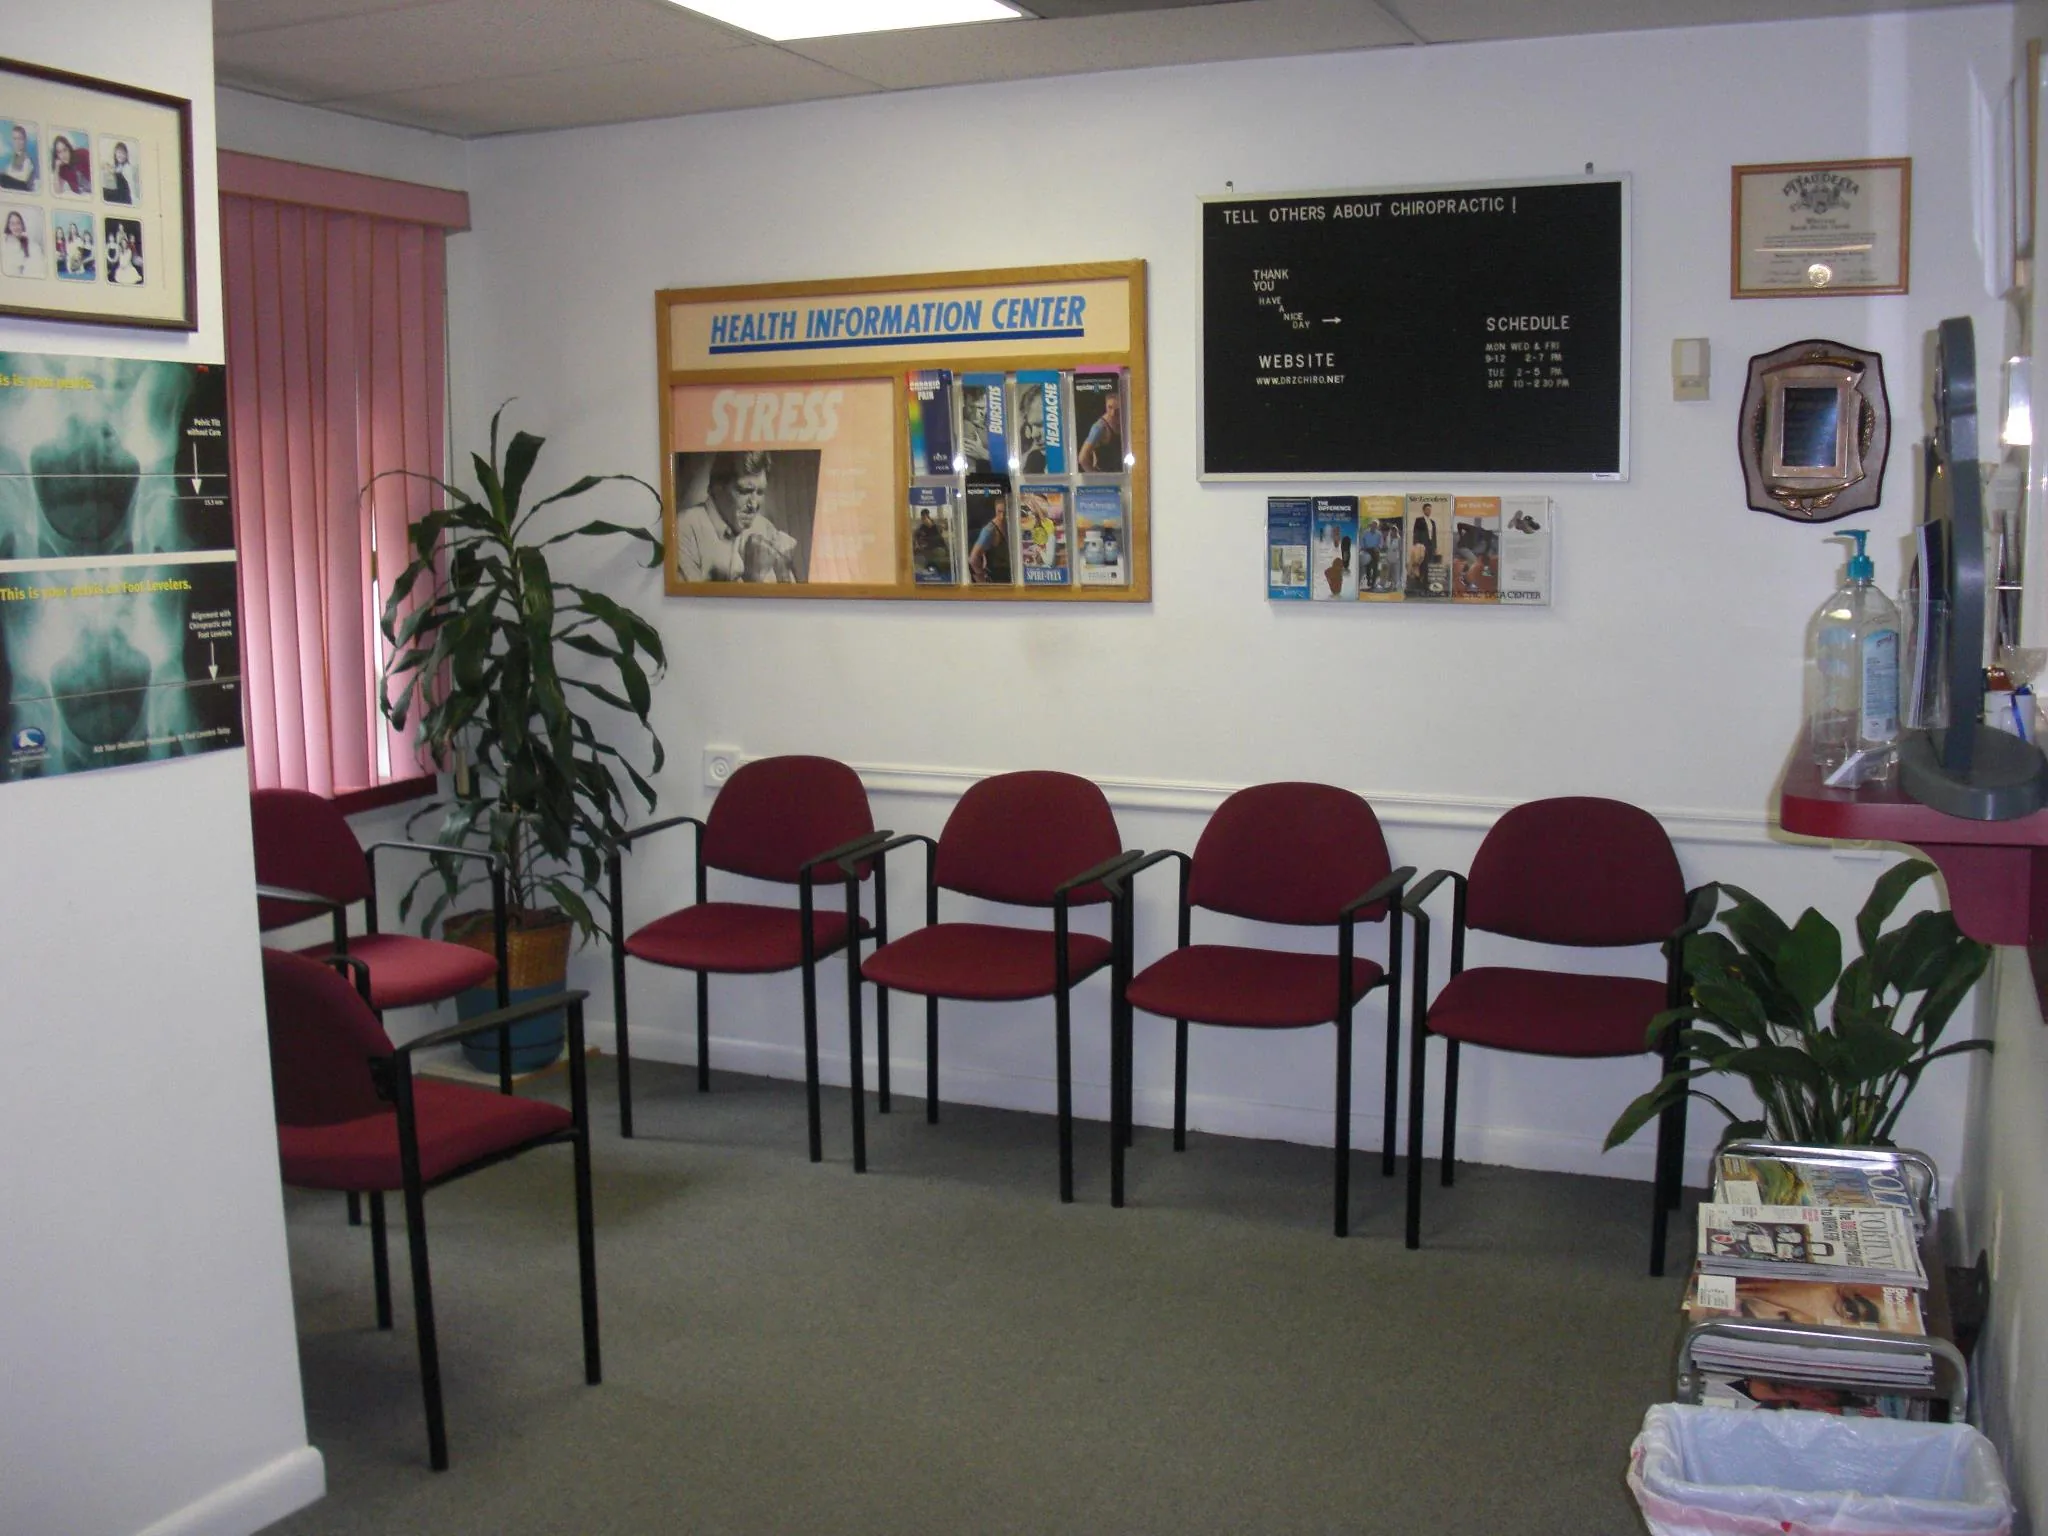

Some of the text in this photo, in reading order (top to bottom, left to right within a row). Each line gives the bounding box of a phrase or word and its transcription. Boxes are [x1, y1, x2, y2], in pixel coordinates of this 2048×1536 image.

[1223, 208, 1259, 225] TELL
[1269, 206, 1326, 223] OTHERS
[1333, 202, 1382, 219] ABOUT
[1390, 197, 1505, 216] CHIROPRACTIC
[1252, 268, 1290, 281] THANK
[1252, 280, 1275, 292] YOU
[1258, 296, 1282, 306] HAVE
[1279, 304, 1285, 313] A
[711, 295, 1087, 344] HEALTH INFORMATION CENTER
[1283, 312, 1304, 321] NICE
[1292, 320, 1311, 329] DAY
[1486, 314, 1571, 332] SCHEDULE
[1485, 342, 1506, 351] MON
[1510, 341, 1530, 351] WED
[1545, 341, 1560, 351] FRI
[1258, 353, 1336, 369] WEBSITE
[1487, 367, 1506, 378] TUE
[1487, 379, 1504, 389] SAT
[988, 385, 1004, 435] BURSITIS
[1044, 382, 1061, 447] HEADACHE
[707, 388, 844, 447] STRESS
[0, 587, 26, 601] This
[29, 586, 40, 600] is
[122, 582, 145, 594] Foot
[146, 578, 192, 592] Levelers.
[1506, 591, 1541, 600] CENTER
[1820, 1209, 1835, 1217] to
[1839, 1209, 1856, 1221] The
[1858, 1210, 1896, 1268] FORTUNE
